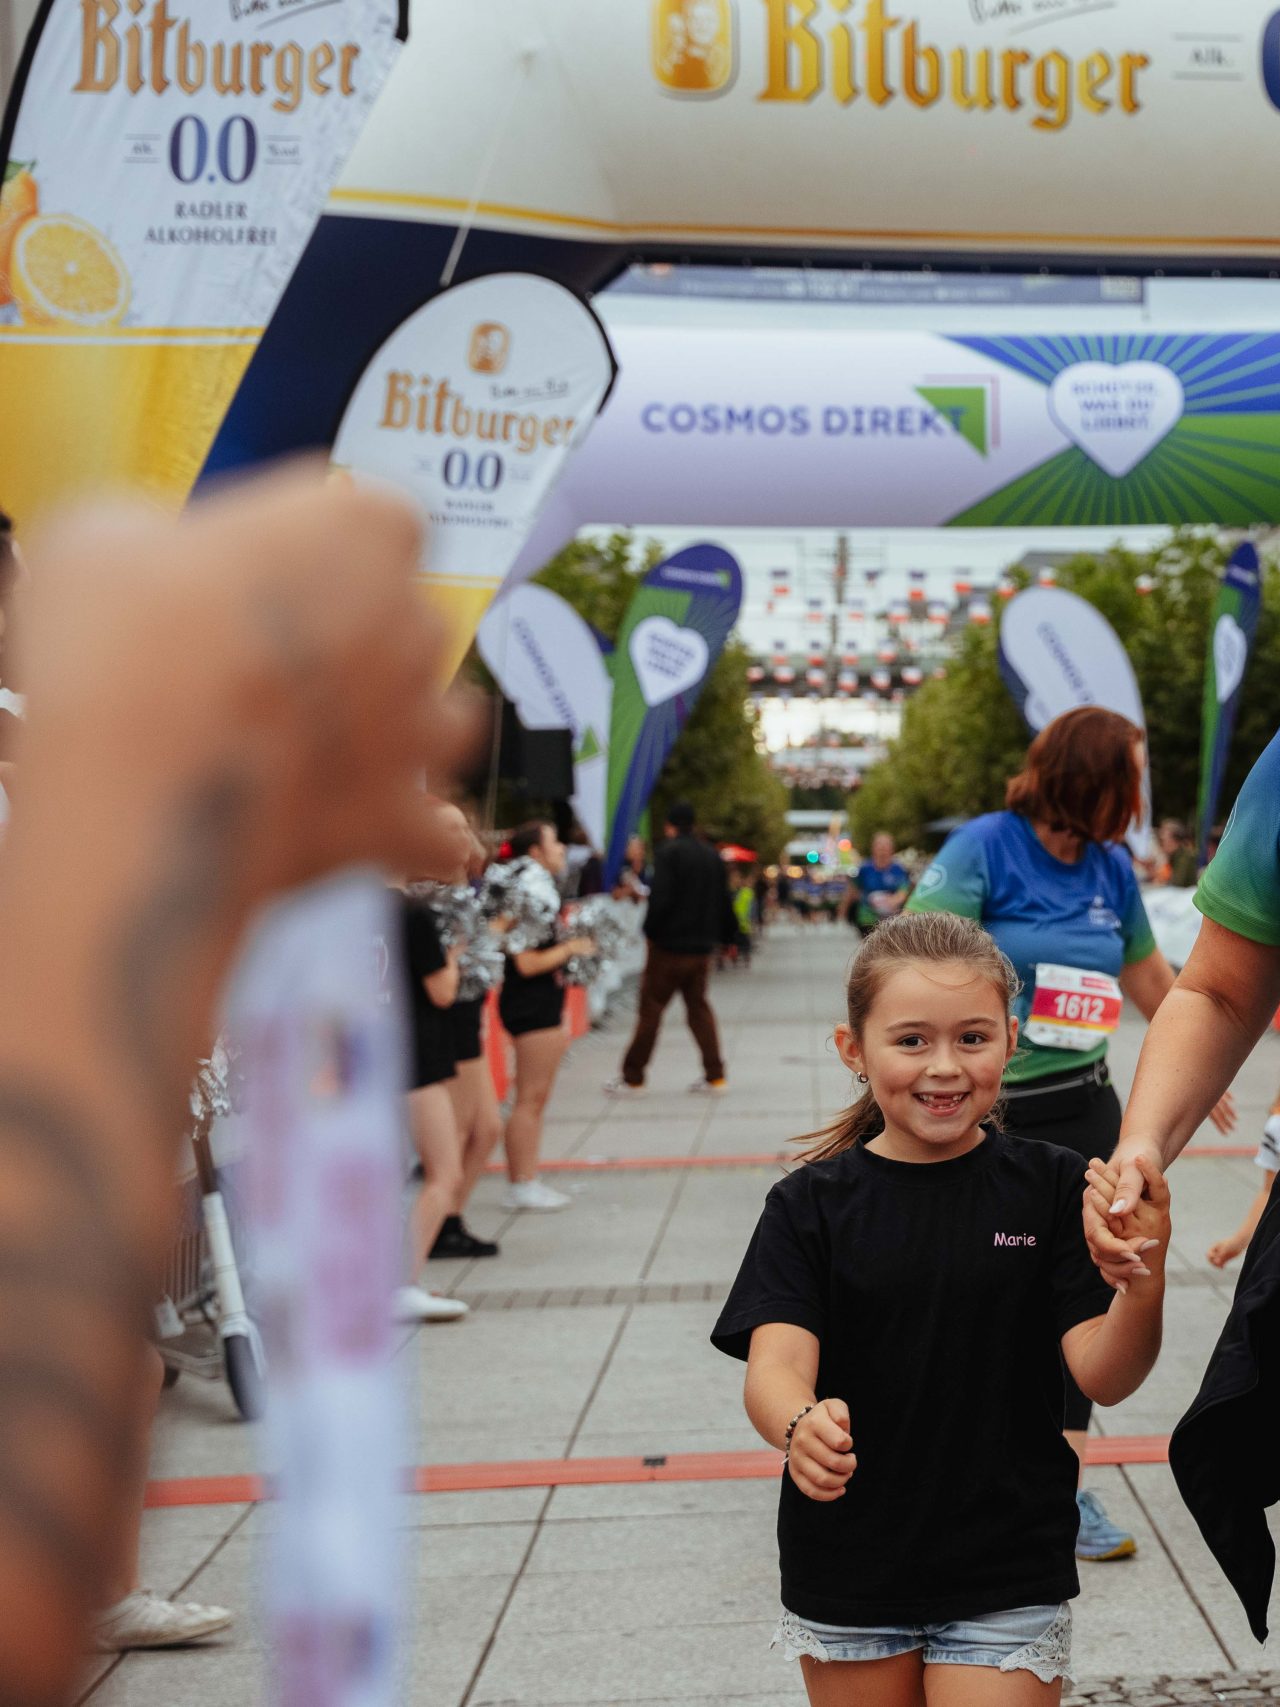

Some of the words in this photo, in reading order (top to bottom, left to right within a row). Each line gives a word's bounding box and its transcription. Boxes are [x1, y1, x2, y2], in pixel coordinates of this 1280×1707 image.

[71, 0, 360, 112] Bitburger
[757, 0, 1150, 131] Bitburger
[168, 113, 258, 184] 0.0
[174, 200, 248, 220] RADLER
[144, 226, 277, 245] ALKOHOLFREI
[378, 370, 576, 454] Bitburger
[641, 402, 811, 436] COSMOS
[822, 404, 968, 437] DIREKT
[1054, 993, 1106, 1023] 1612
[994, 1232, 1036, 1247] Marie
